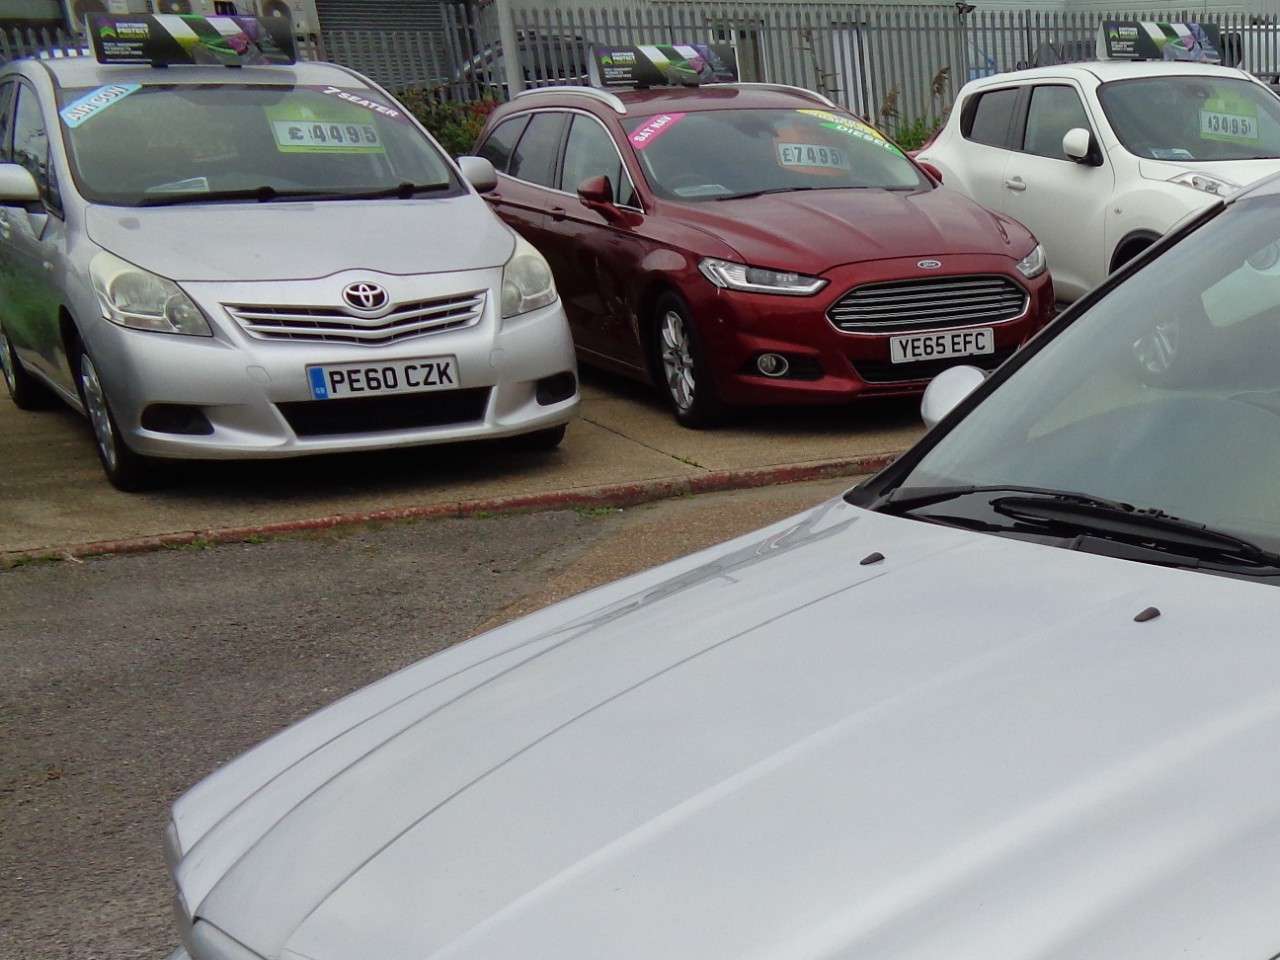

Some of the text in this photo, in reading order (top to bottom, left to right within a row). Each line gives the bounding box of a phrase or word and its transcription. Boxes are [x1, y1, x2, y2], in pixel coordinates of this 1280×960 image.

[338, 92, 399, 118] SEATER
[288, 124, 377, 144] £4495
[899, 332, 986, 358] YE65 EFC
[329, 362, 454, 393] PE60 CZK
